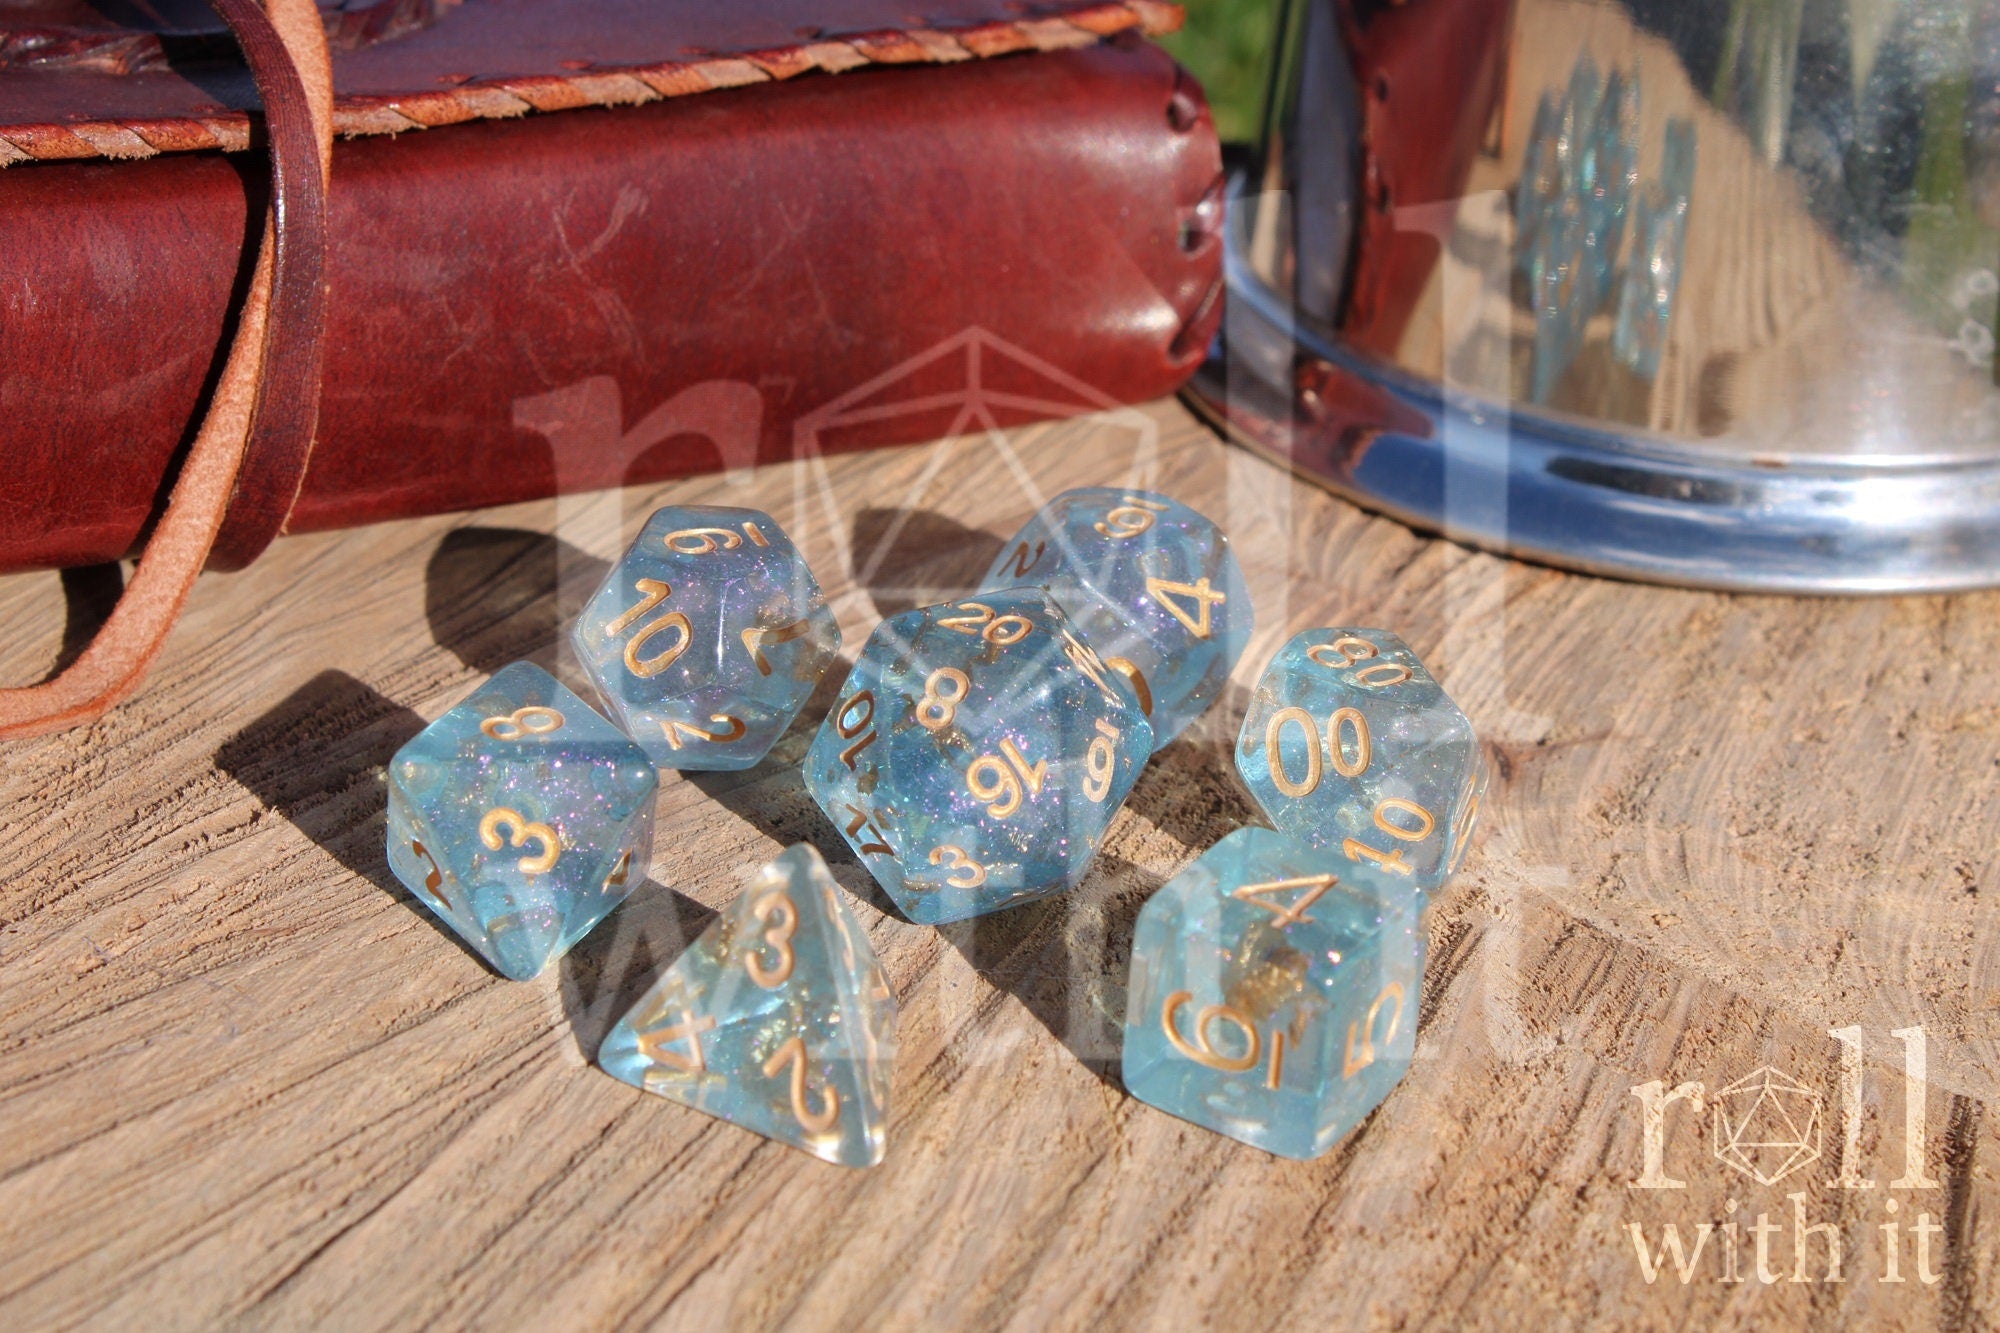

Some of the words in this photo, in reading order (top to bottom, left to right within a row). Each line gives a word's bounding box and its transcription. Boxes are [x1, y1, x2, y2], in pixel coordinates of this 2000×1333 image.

[605, 578, 694, 678] 10
[937, 603, 1034, 645] 20
[1146, 577, 1226, 640] 4
[1307, 637, 1414, 688] 80
[480, 706, 565, 741] 8
[917, 667, 972, 730] 8
[1265, 707, 1372, 798] 00
[479, 807, 561, 874] 3
[929, 845, 987, 889] 3
[1233, 874, 1339, 929] 4
[745, 891, 799, 989] 3
[763, 1037, 841, 1132] 2
